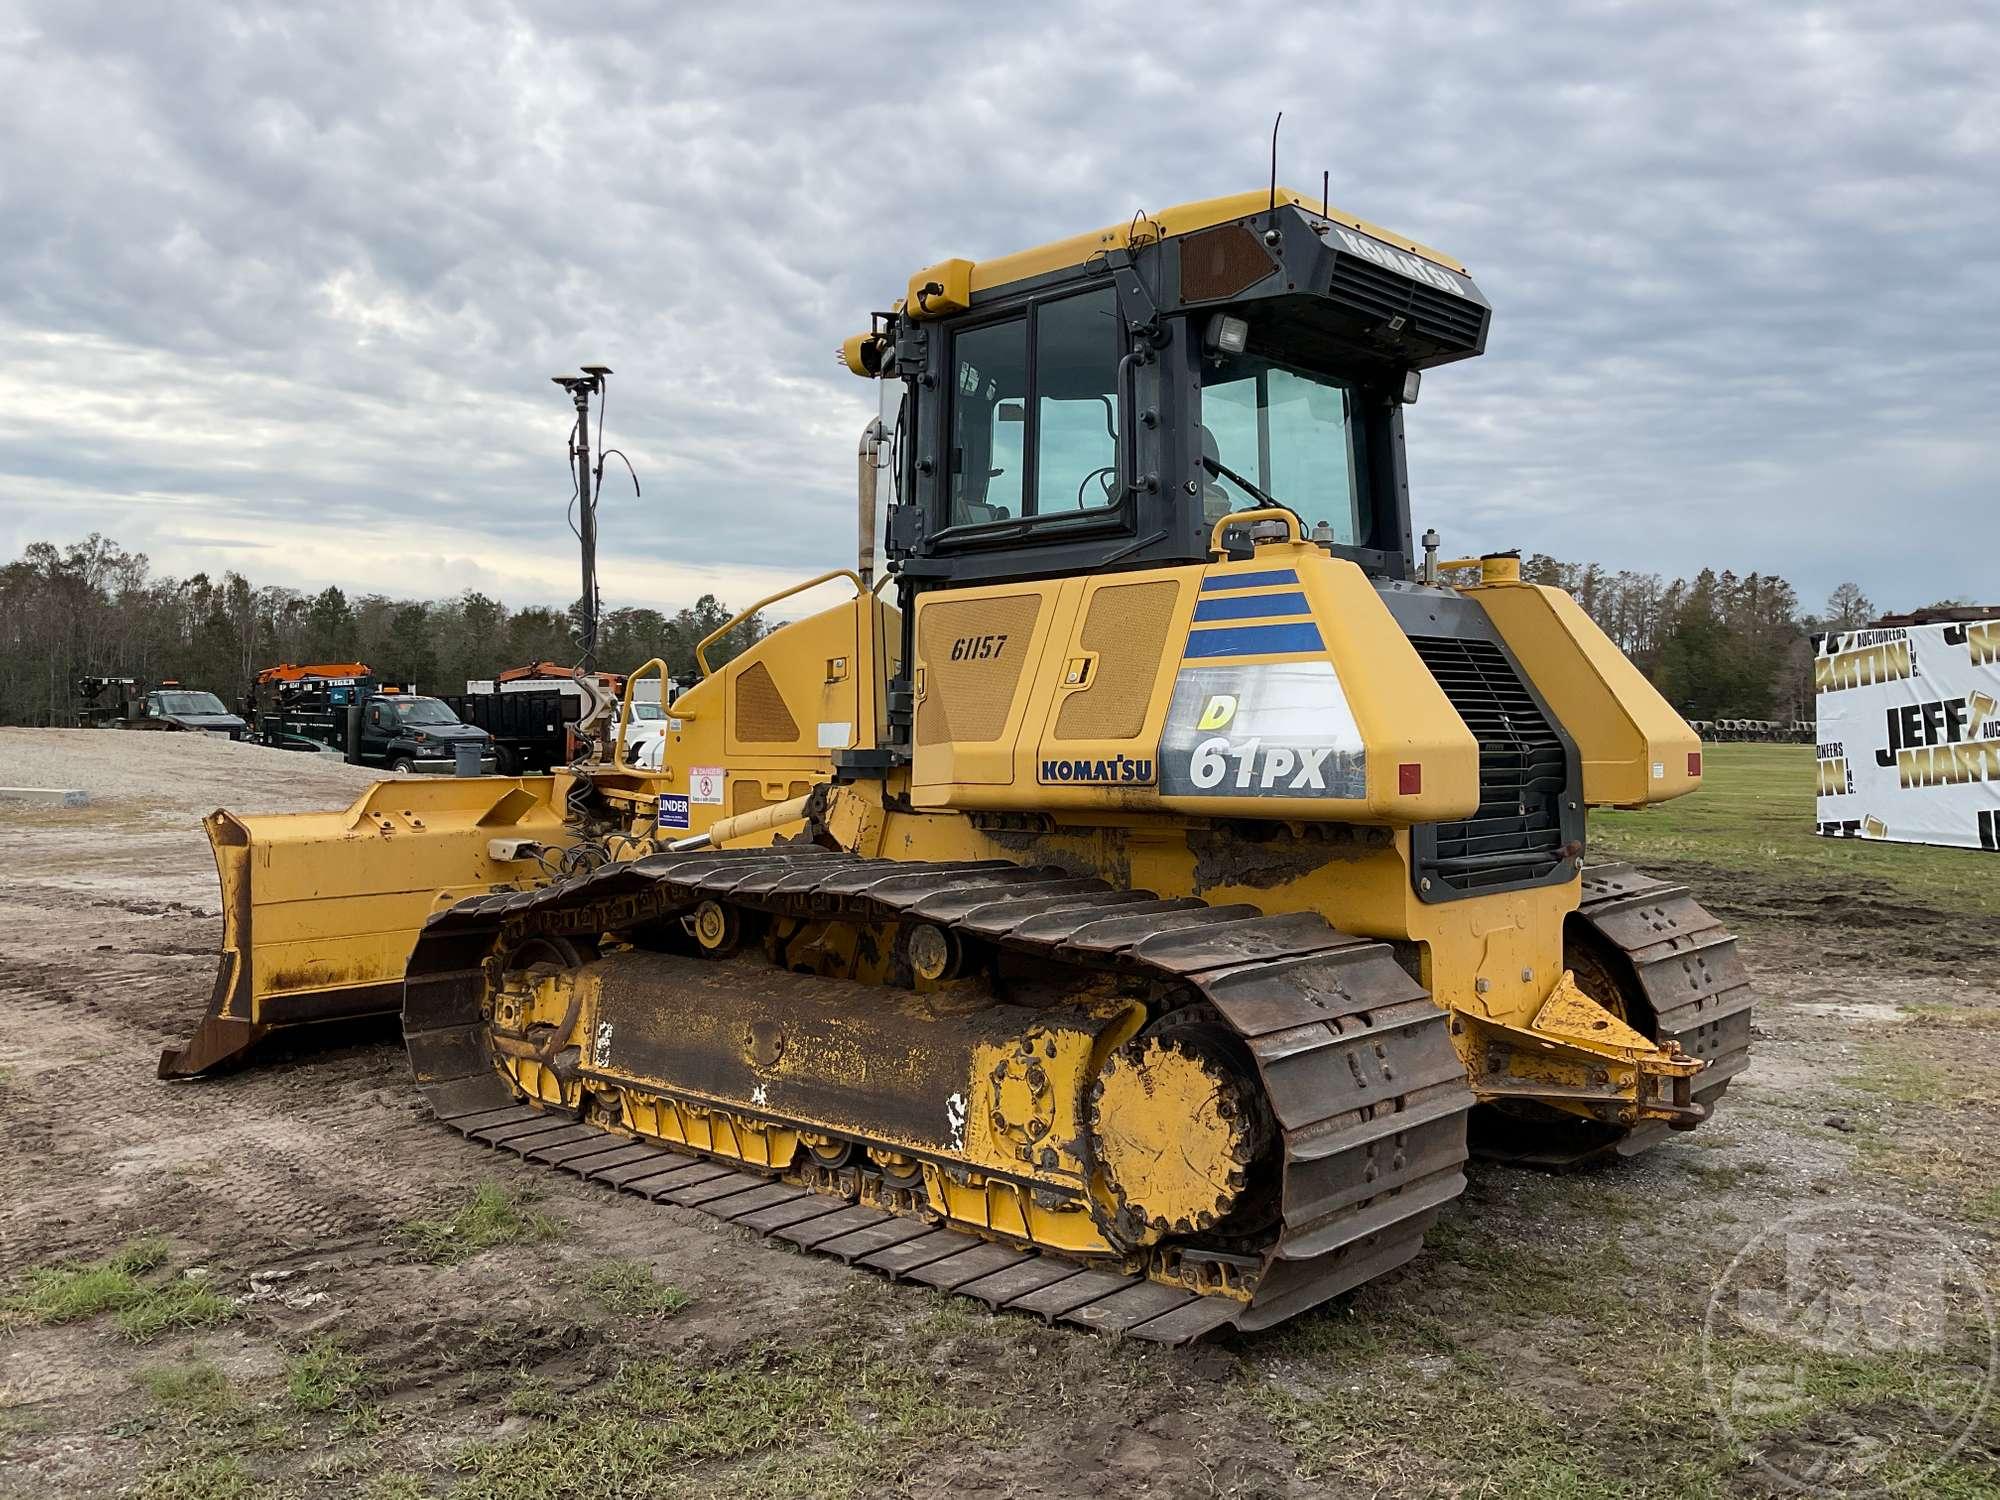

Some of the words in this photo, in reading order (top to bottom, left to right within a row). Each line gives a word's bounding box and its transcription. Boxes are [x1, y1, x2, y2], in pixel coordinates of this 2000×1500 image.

[1336, 229, 1465, 296] KOMATSU
[951, 634, 1008, 661] 61157
[327, 679, 355, 687] TIGER
[1197, 695, 1238, 730] D
[1875, 698, 1968, 767] JEFF
[1042, 754, 1152, 781] KOMATSU
[1190, 737, 1332, 789] 61PX
[659, 799, 688, 813] LINDER
